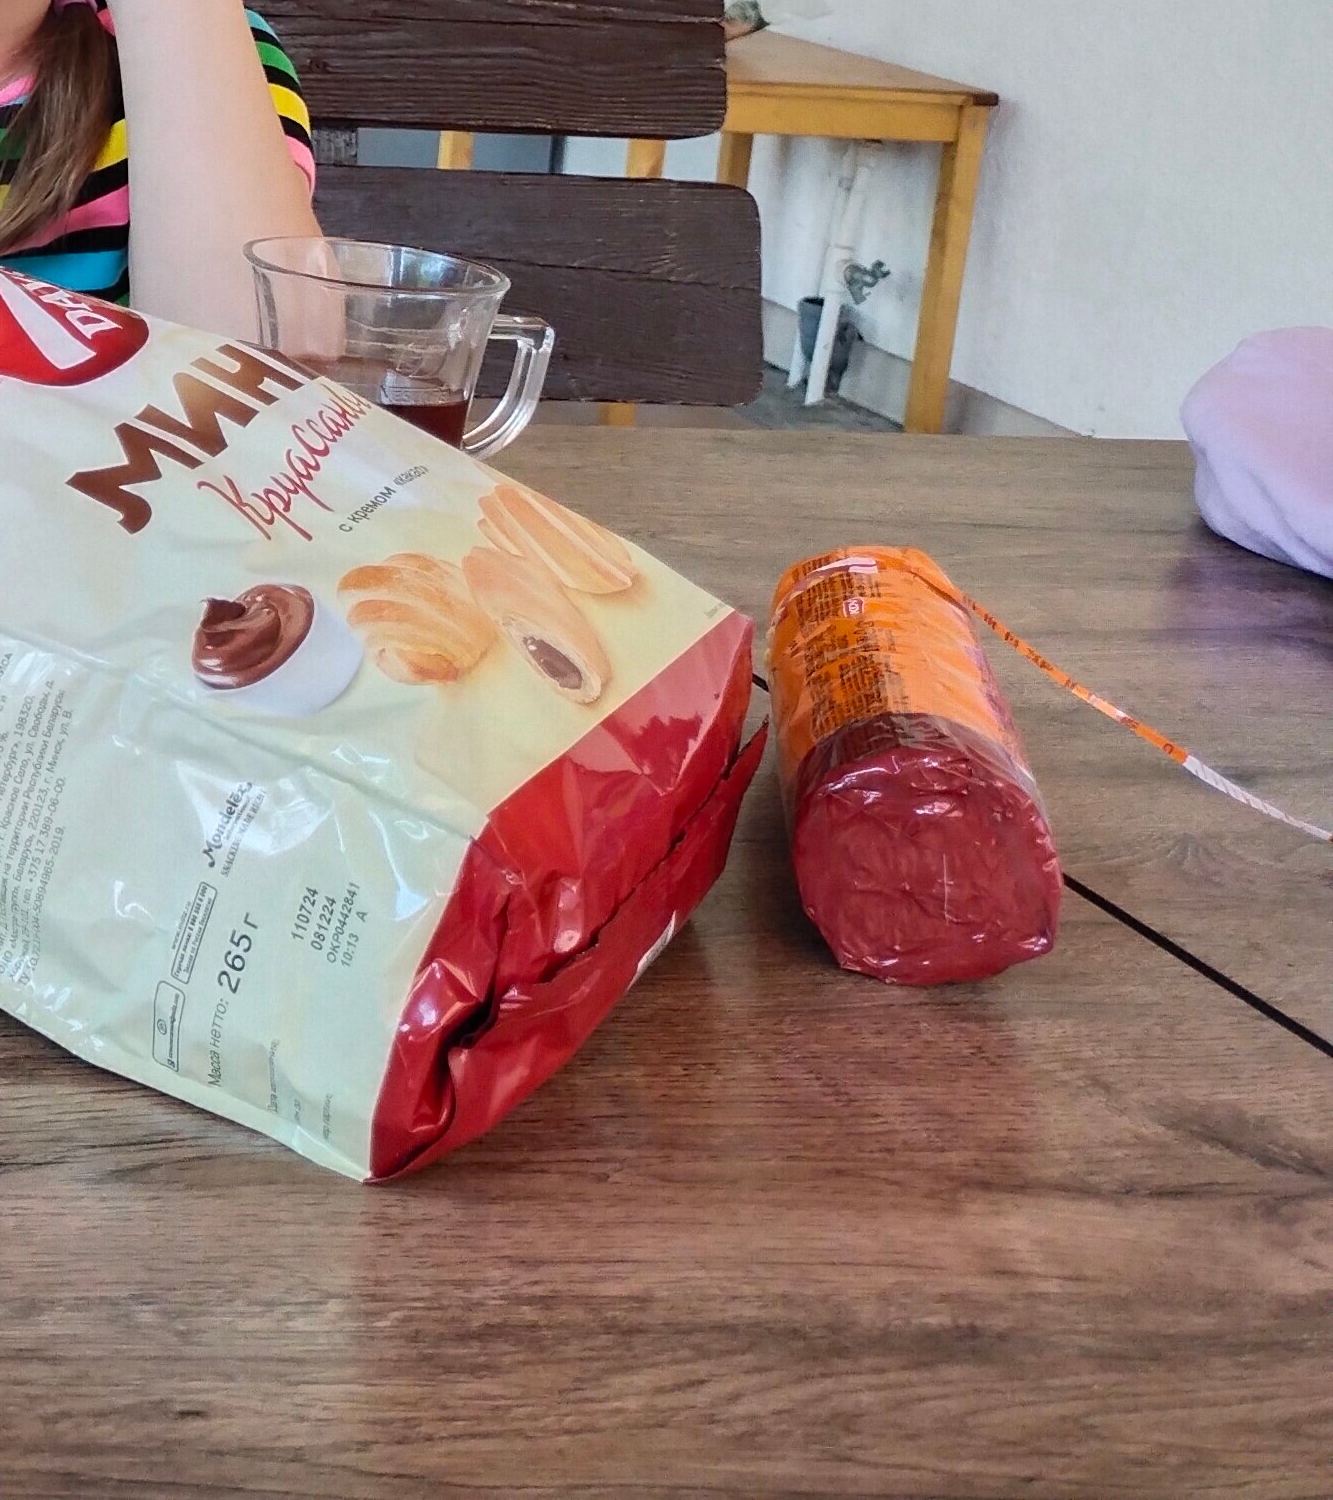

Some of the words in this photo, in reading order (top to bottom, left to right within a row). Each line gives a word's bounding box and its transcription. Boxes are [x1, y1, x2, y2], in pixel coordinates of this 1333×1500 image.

[1, 272, 123, 340] DAY
[347, 486, 396, 523] кремом
[12, 692, 35, 737] 198320,
[12, 755, 30, 784] Село,
[26, 690, 50, 738] Свободы,
[5, 800, 30, 861] территории
[21, 739, 49, 799] Республики
[11, 832, 36, 881] Беларусь,
[26, 784, 50, 830] 220123,
[45, 736, 65, 773] Минск,
[24, 855, 42, 883] +375
[38, 775, 67, 838] 389-06-00.
[241, 910, 261, 930] г
[289, 885, 320, 942] 110724
[309, 894, 338, 951] 081224
[214, 927, 255, 994] 265
[339, 932, 361, 969] 10:13
[207, 996, 229, 1048] нетто:
[207, 1050, 221, 1086] Масса
